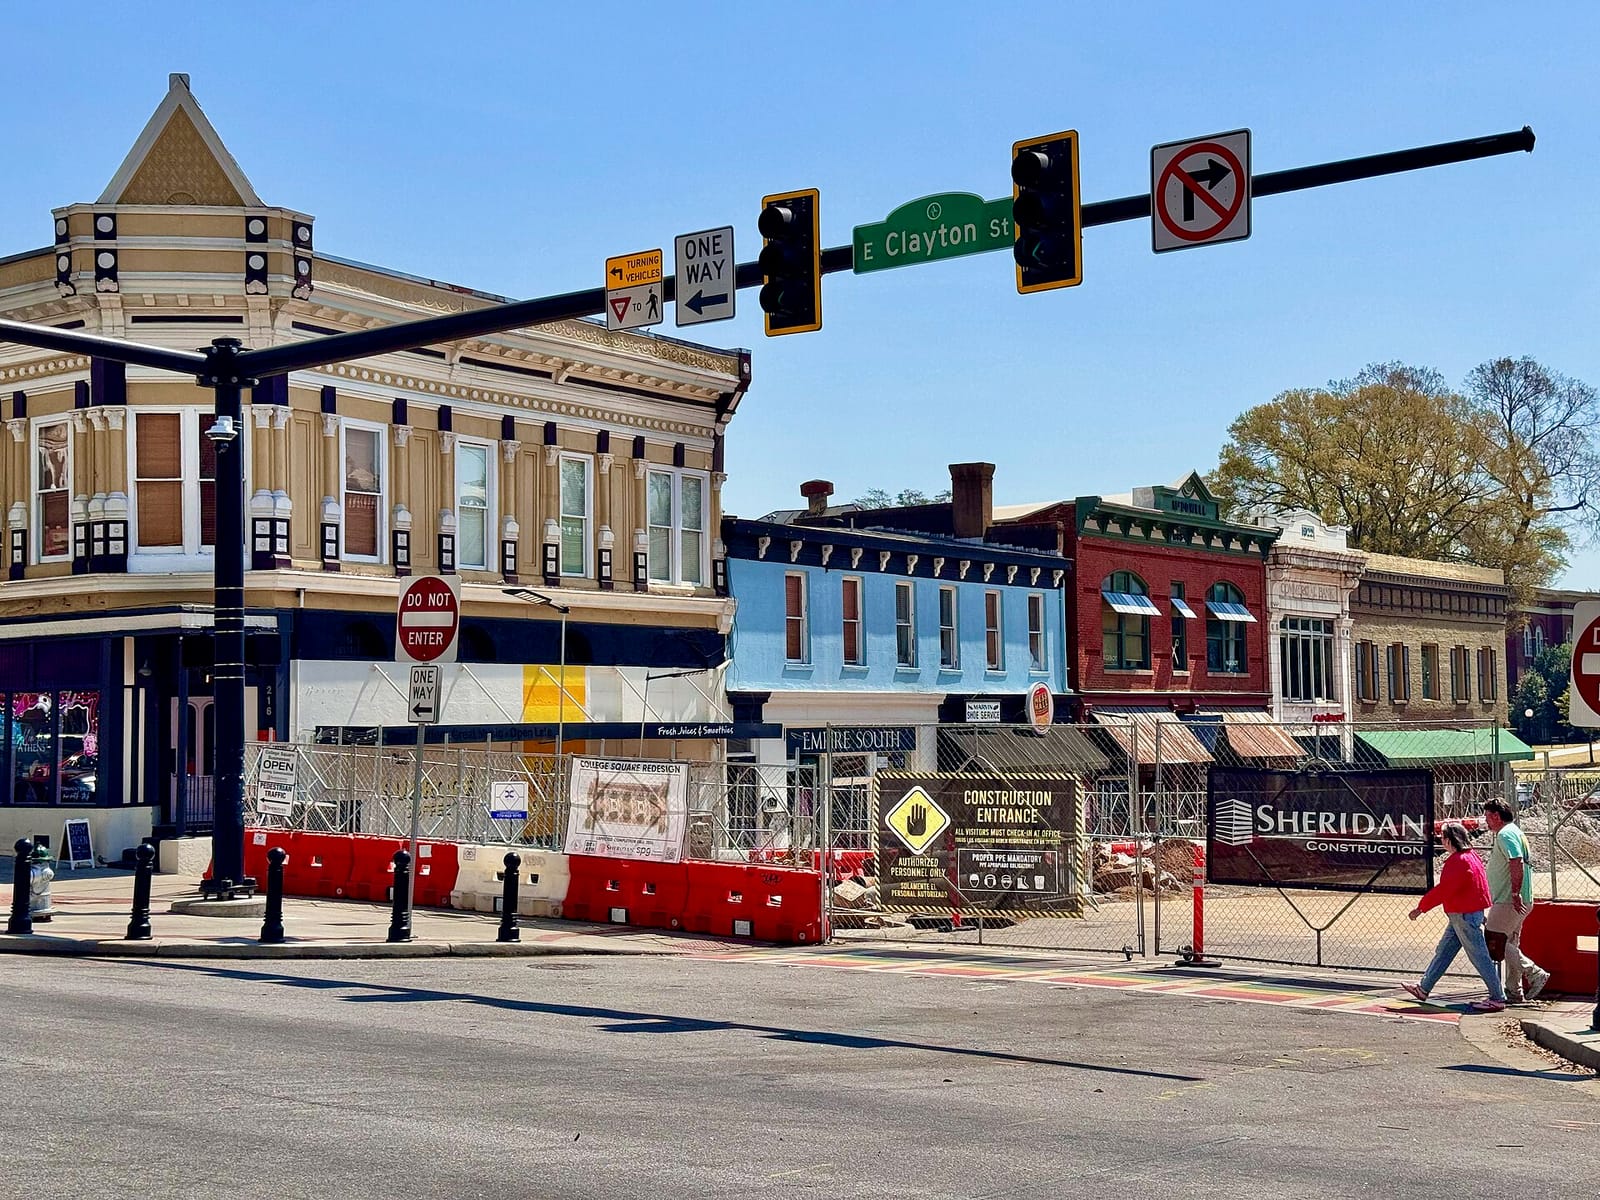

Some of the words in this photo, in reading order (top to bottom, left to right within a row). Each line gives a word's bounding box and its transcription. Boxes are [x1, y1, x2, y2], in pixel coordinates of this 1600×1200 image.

[864, 242, 873, 260] E
[886, 223, 976, 256] Clayton
[990, 217, 1009, 238] St
[685, 235, 723, 259] ONE
[627, 256, 659, 269] TURNING
[625, 268, 660, 282] VEHICLES
[686, 259, 725, 284] WAY
[632, 302, 642, 312] TO
[407, 593, 422, 607] DO
[428, 592, 451, 607] NOT
[408, 632, 443, 645] ENTER
[413, 670, 434, 683] ONE
[412, 686, 434, 700] WAY
[967, 711, 979, 720] SHOE
[980, 711, 1000, 720] SERVICE
[657, 726, 677, 736] Fresh
[677, 726, 697, 736] Juices
[703, 725, 734, 735] Smoothies
[856, 731, 900, 748] SOUTH
[263, 760, 294, 771] OPEN
[580, 760, 608, 770] COLLEGE
[611, 761, 641, 772] SQUARE
[642, 763, 681, 774] REDESIGN
[260, 783, 292, 792] PEDESTRIAN
[265, 791, 286, 799] TRAFFIC
[964, 790, 1052, 806] CONSTRUCTION
[977, 808, 1038, 823] ENTRANCE
[1256, 804, 1424, 837] SHERIDAN
[955, 828, 964, 836] ALL
[965, 828, 989, 836] VISITORS
[990, 828, 1006, 836] MUST
[1006, 829, 1033, 837] CHECK-IN
[1033, 829, 1040, 837] AT
[1041, 829, 1061, 838] OFFICE
[636, 846, 651, 856] spg
[1306, 840, 1424, 855] CONSTRUCTION
[898, 857, 939, 867] AUTHORIZED
[972, 853, 994, 862] PROPER
[995, 854, 1006, 862] PPE
[1007, 854, 1042, 863] MANDATORY
[890, 867, 928, 877] PERSONNEL
[929, 868, 946, 878] ONLY
[900, 882, 930, 890] SOLAMENTE
[891, 889, 916, 898] PERSONAL
[917, 890, 948, 898] AUTORIZADO
